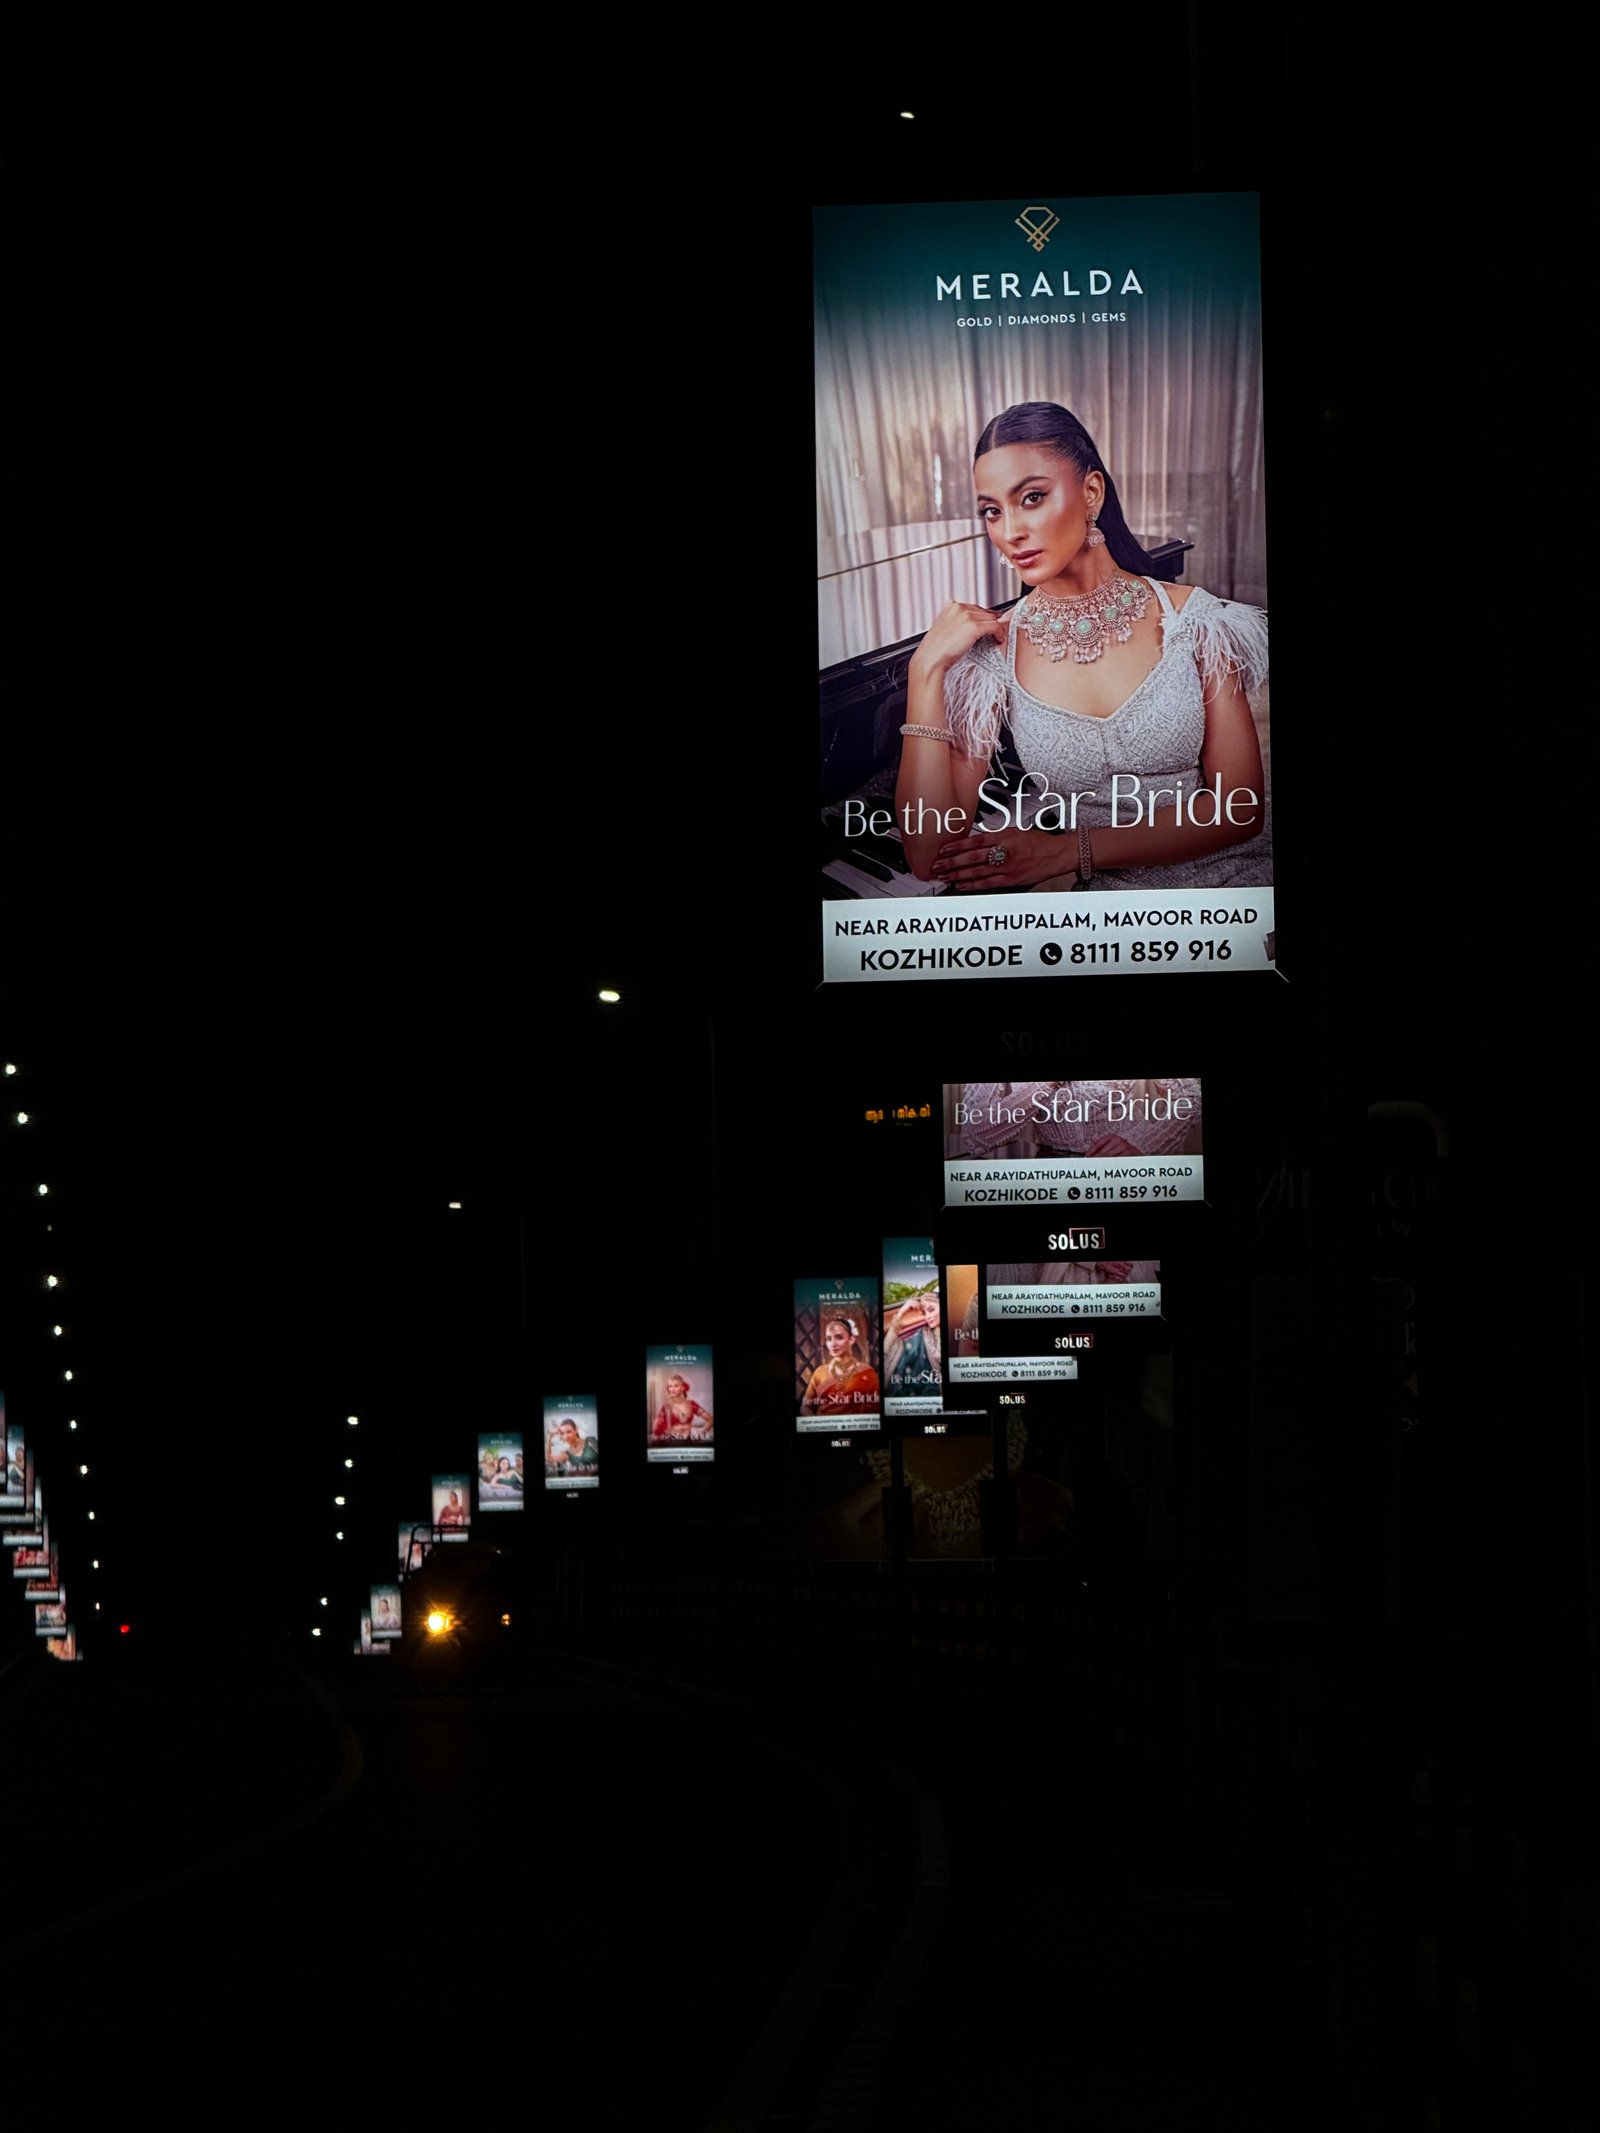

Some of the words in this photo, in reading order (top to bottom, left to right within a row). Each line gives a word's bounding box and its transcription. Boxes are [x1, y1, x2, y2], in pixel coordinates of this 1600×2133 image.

[936, 268, 1144, 301] MERALDA
[956, 316, 993, 327] GOLD
[1008, 313, 1076, 325] DIAMONDS
[1092, 312, 1127, 323] GEMS
[844, 800, 893, 838] Be
[901, 797, 967, 835] the
[977, 772, 1097, 833] Star
[1111, 772, 1258, 829] Bride
[835, 919, 890, 937] NEAR
[895, 912, 1097, 934] ARAYIDATHUPALAM,
[1104, 909, 1193, 927] MAVOOR
[1200, 908, 1258, 925] ROAD
[860, 945, 1023, 971] KOZHIKODE
[1070, 942, 1121, 964] 8111
[1131, 940, 1179, 961] 859
[1188, 939, 1232, 961] 916
[954, 1103, 984, 1126] Be
[989, 1101, 1026, 1125] the
[1031, 1088, 1101, 1124] Star
[1107, 1088, 1193, 1122] Bride
[951, 1172, 982, 1182] NEAR
[985, 1169, 1100, 1182] ARAYIDATHUPALAM,
[1104, 1168, 1156, 1179] MAVOOR
[1159, 1167, 1193, 1177] ROAD
[965, 1188, 1058, 1202] KOZHIKODE
[1085, 1187, 1114, 1199] 8111
[1119, 1186, 1148, 1198] 859
[1153, 1185, 1178, 1197] 916
[1048, 1233, 1100, 1250] SOLUS
[819, 1292, 861, 1300] MERALDA
[1015, 1292, 1093, 1301] ARAYIDATHUPALAM,
[1096, 1291, 1131, 1299] MAVOOR
[1133, 1290, 1156, 1298] ROAD
[1001, 1304, 1065, 1314] KOZHIKODE
[1082, 1304, 1103, 1314] 8111
[1106, 1303, 1125, 1313] 859
[1128, 1303, 1146, 1312] 916
[1055, 1336, 1090, 1349] SOLUS
[921, 1370, 943, 1383] Sta
[961, 1370, 1008, 1378] KOZHIKODE
[1037, 1369, 1052, 1377] 859
[1053, 1369, 1067, 1377] 916
[999, 1395, 1026, 1405] SOLUS
